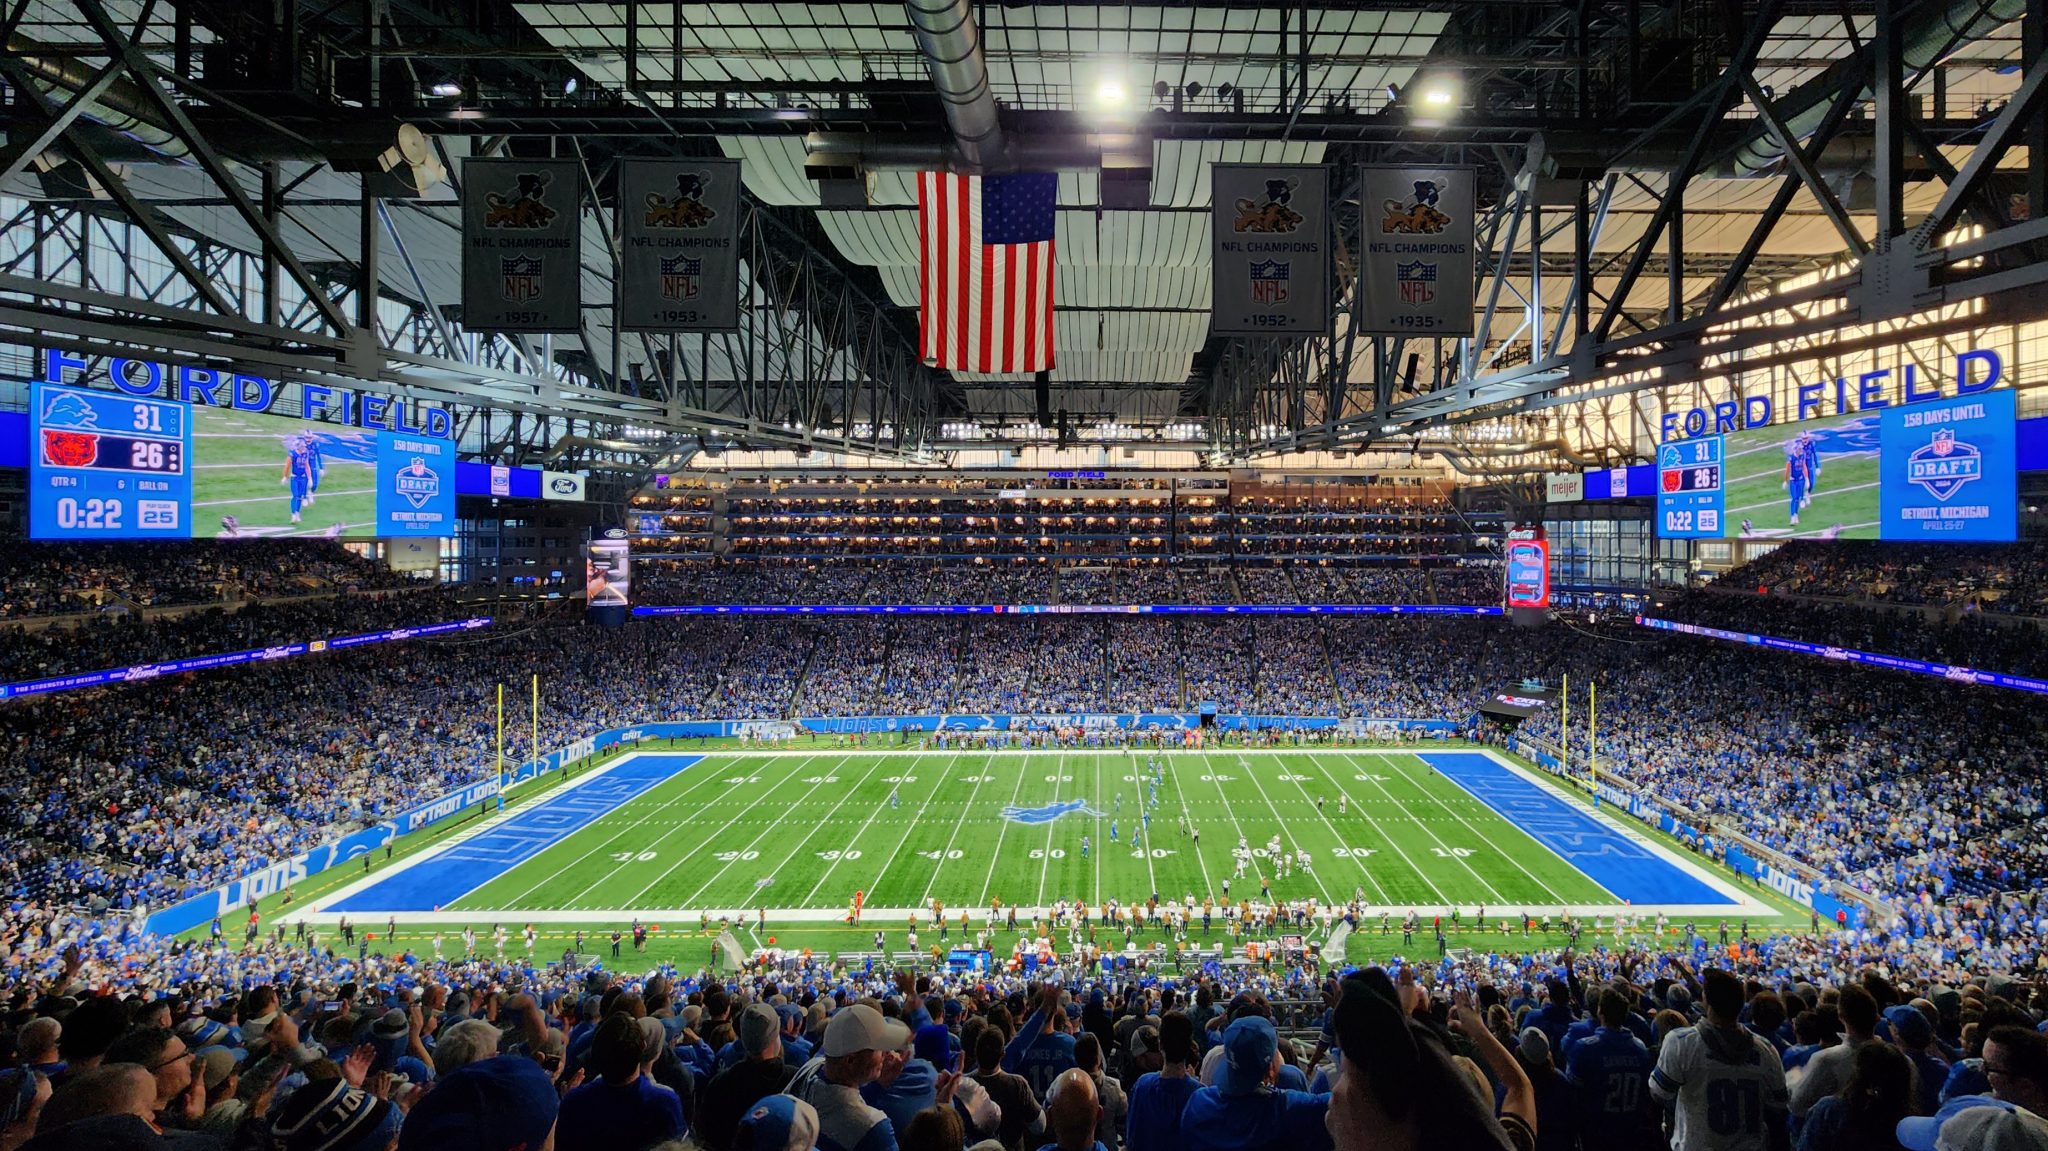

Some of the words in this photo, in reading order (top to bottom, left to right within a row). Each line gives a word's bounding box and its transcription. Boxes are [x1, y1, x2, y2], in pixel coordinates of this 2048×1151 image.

[472, 237, 495, 248] NFL
[500, 237, 571, 248] CHAMPIONS
[632, 237, 653, 247] NFL
[658, 237, 730, 248] CHAMPIONS
[1222, 242, 1242, 252] NFL
[1247, 242, 1317, 253] CHAMPIONS
[1369, 243, 1390, 252] NFL
[1394, 244, 1465, 254] CHAMPIONS
[506, 276, 540, 297] NFL
[664, 276, 697, 296] NFL
[1253, 280, 1286, 301] NFL
[1401, 281, 1433, 301] NFL
[505, 312, 538, 323] 1957
[661, 311, 697, 322] 1953
[1252, 315, 1286, 326] 1952
[1399, 316, 1433, 327] 1935
[45, 349, 271, 412] FORD
[302, 382, 452, 439] FIELD
[1661, 395, 1772, 442] FORD
[1798, 348, 2004, 421] FIELD
[133, 404, 162, 432] 31
[1904, 413, 1922, 427] 158
[1924, 408, 1950, 425] DAYS
[1952, 403, 1985, 421] UNTIL
[1695, 442, 1710, 461] 31
[1935, 440, 1950, 452] NFL
[132, 442, 163, 468] 26
[1914, 460, 1974, 476] DRAFT
[400, 479, 435, 491] DRAFT
[1694, 468, 1710, 488] 26
[554, 481, 574, 493] Ford
[1552, 478, 1578, 497] meijer
[57, 498, 122, 528] 0:22
[144, 511, 173, 523] 25
[1941, 506, 1989, 518] MICHIGAN
[1666, 511, 1692, 531] 0:22
[1700, 518, 1715, 527] 25
[1923, 521, 1943, 530] APRIL
[263, 647, 290, 659] Ford
[1824, 646, 1848, 660] Ford
[124, 664, 161, 680] Ford
[1945, 666, 1978, 682] Ford
[824, 718, 883, 732] LIONS
[622, 729, 642, 741] GRIT
[560, 736, 596, 768] LIONS
[466, 780, 499, 805] LIONS
[427, 776, 664, 864] LIONS
[1449, 774, 1656, 860] LIONS
[618, 851, 657, 861] 10
[719, 850, 760, 861] 20
[822, 850, 862, 860] 30
[926, 849, 964, 860] 40
[1028, 848, 1066, 859] 50
[1131, 848, 1165, 858] 40
[1332, 847, 1370, 858] 20
[1431, 847, 1472, 858] 10
[217, 854, 309, 916] LIONS
[1756, 862, 1814, 908] LIONS
[1603, 1072, 1640, 1112] 20
